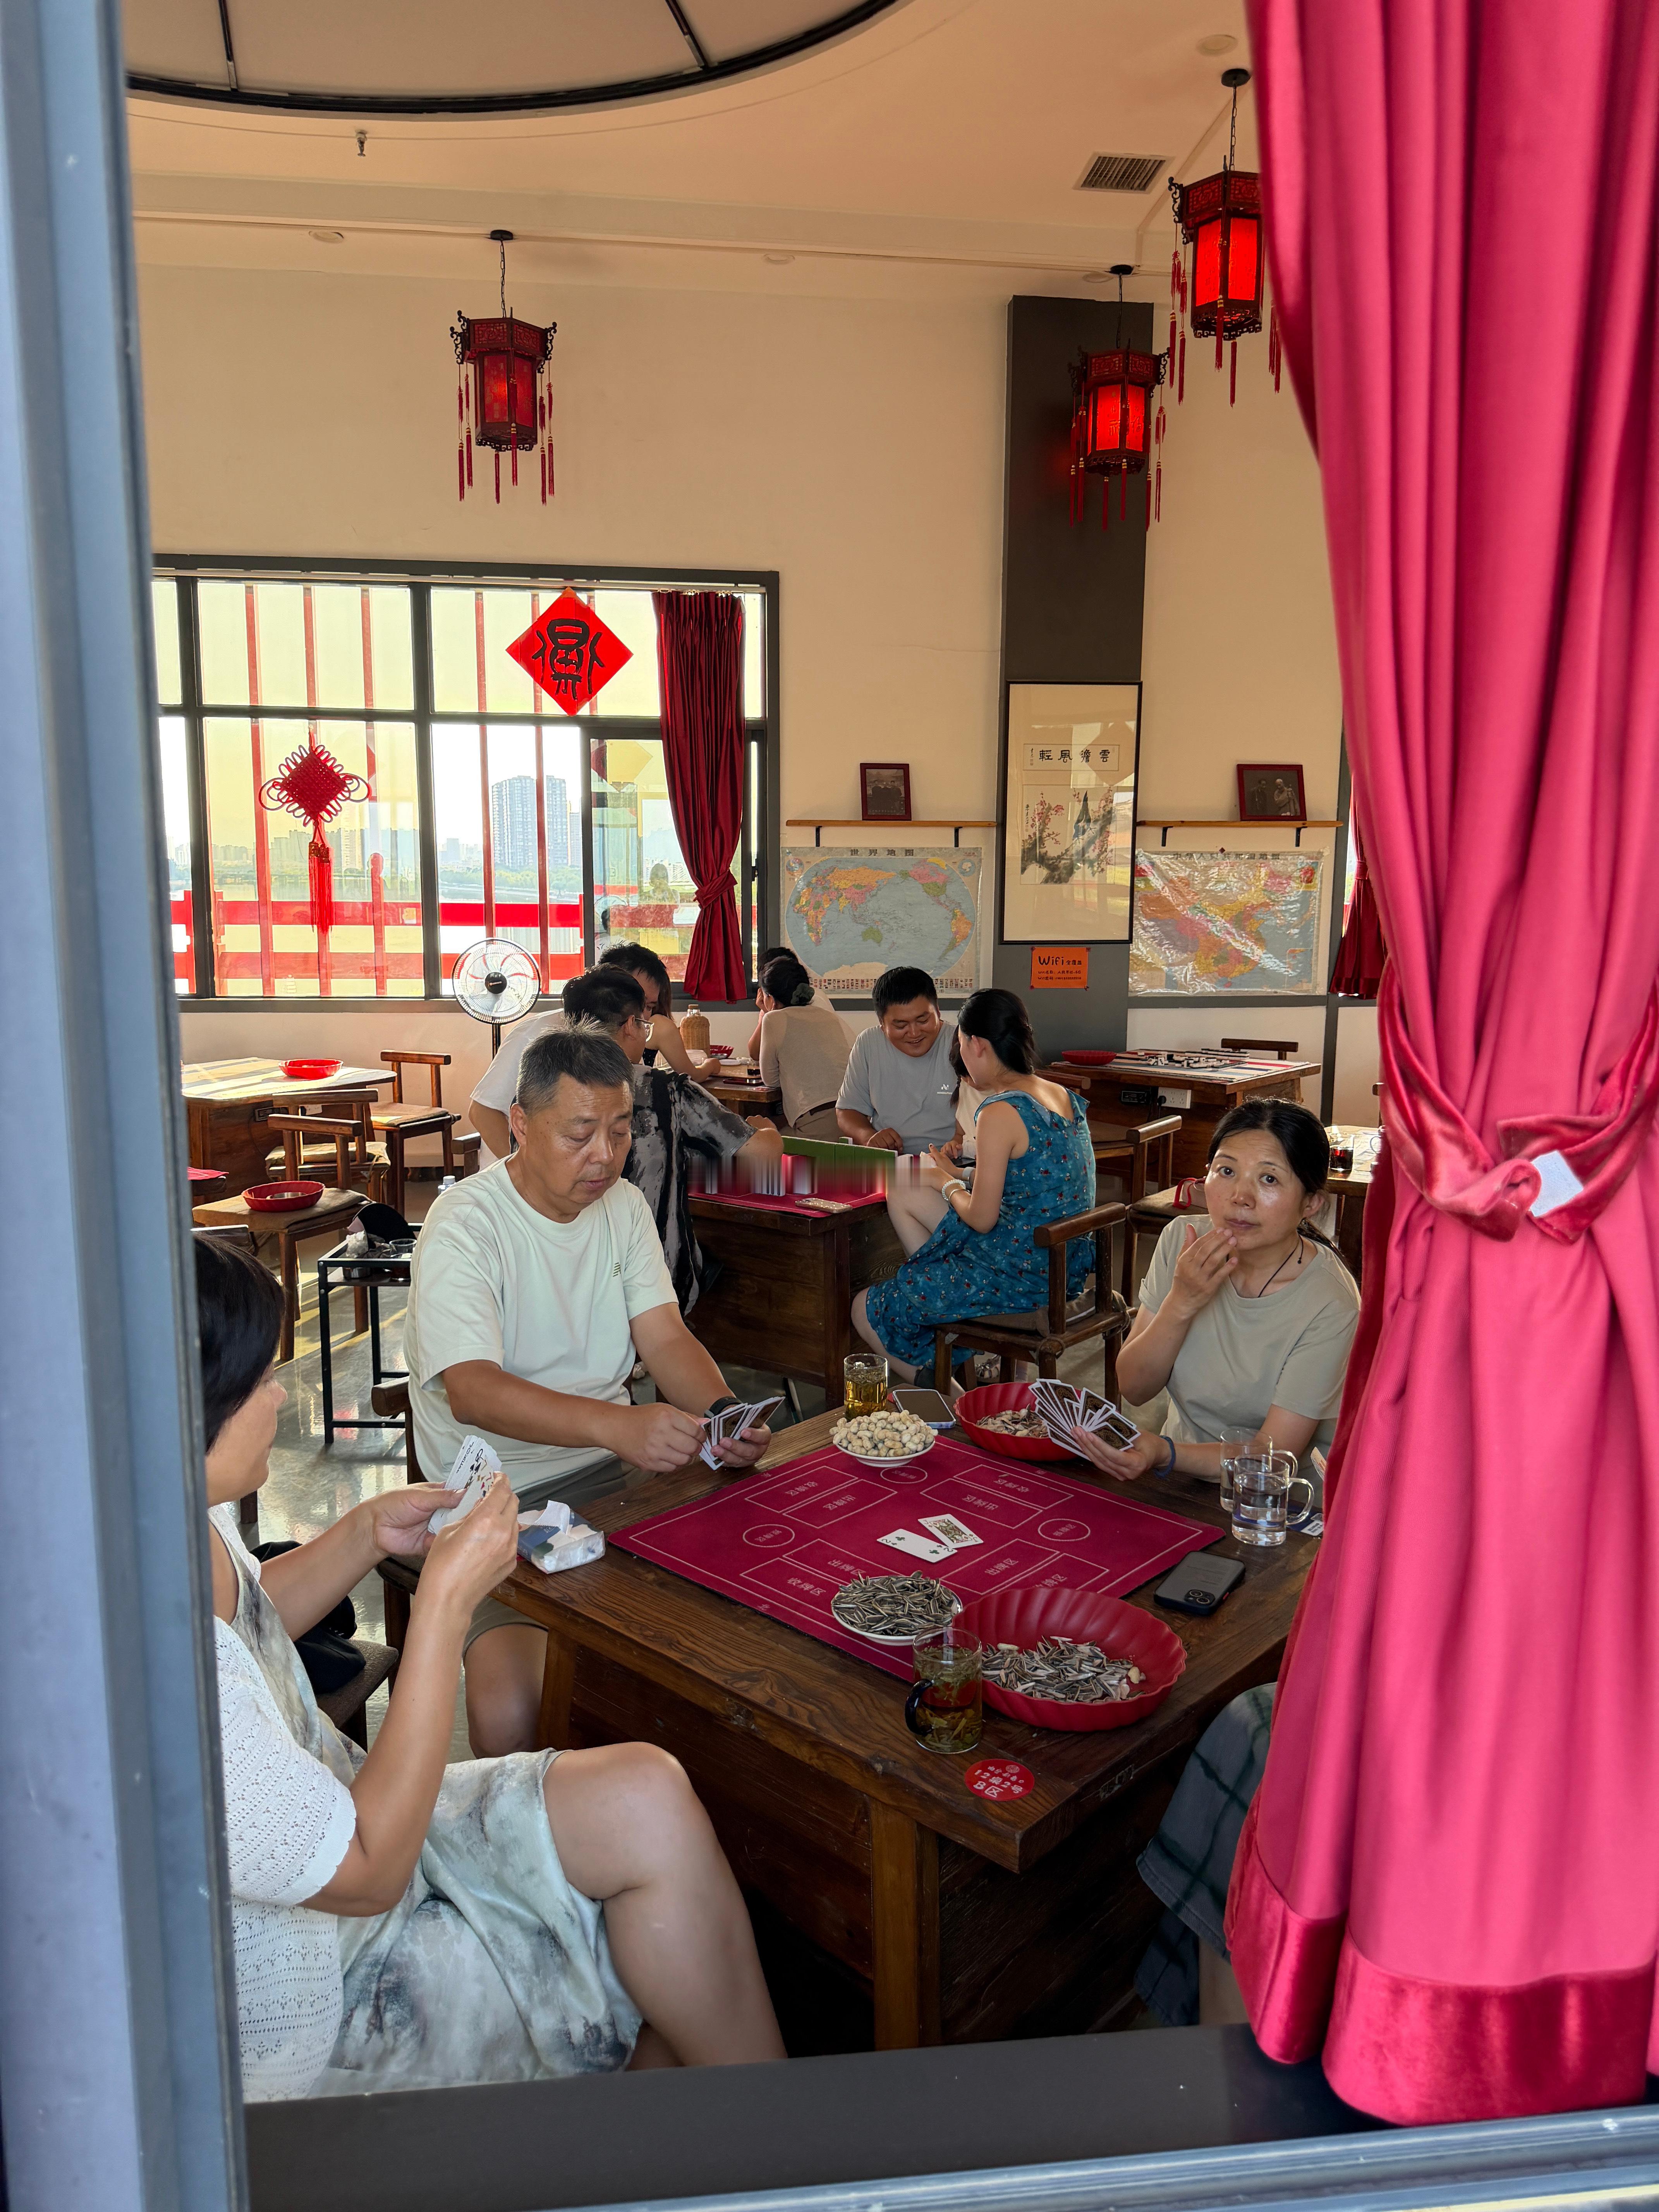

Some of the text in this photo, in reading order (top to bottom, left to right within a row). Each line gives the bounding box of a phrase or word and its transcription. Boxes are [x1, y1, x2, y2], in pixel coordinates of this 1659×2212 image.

[1038, 956, 1064, 965] Wifi
[823, 1495, 856, 1510] 出牌区
[962, 1494, 999, 1510] 出牌区
[828, 1559, 866, 1576] 出牌区
[985, 1558, 1019, 1575] 出牌区
[787, 1578, 826, 1596] 收牌区
[973, 1780, 1004, 1798] B区
